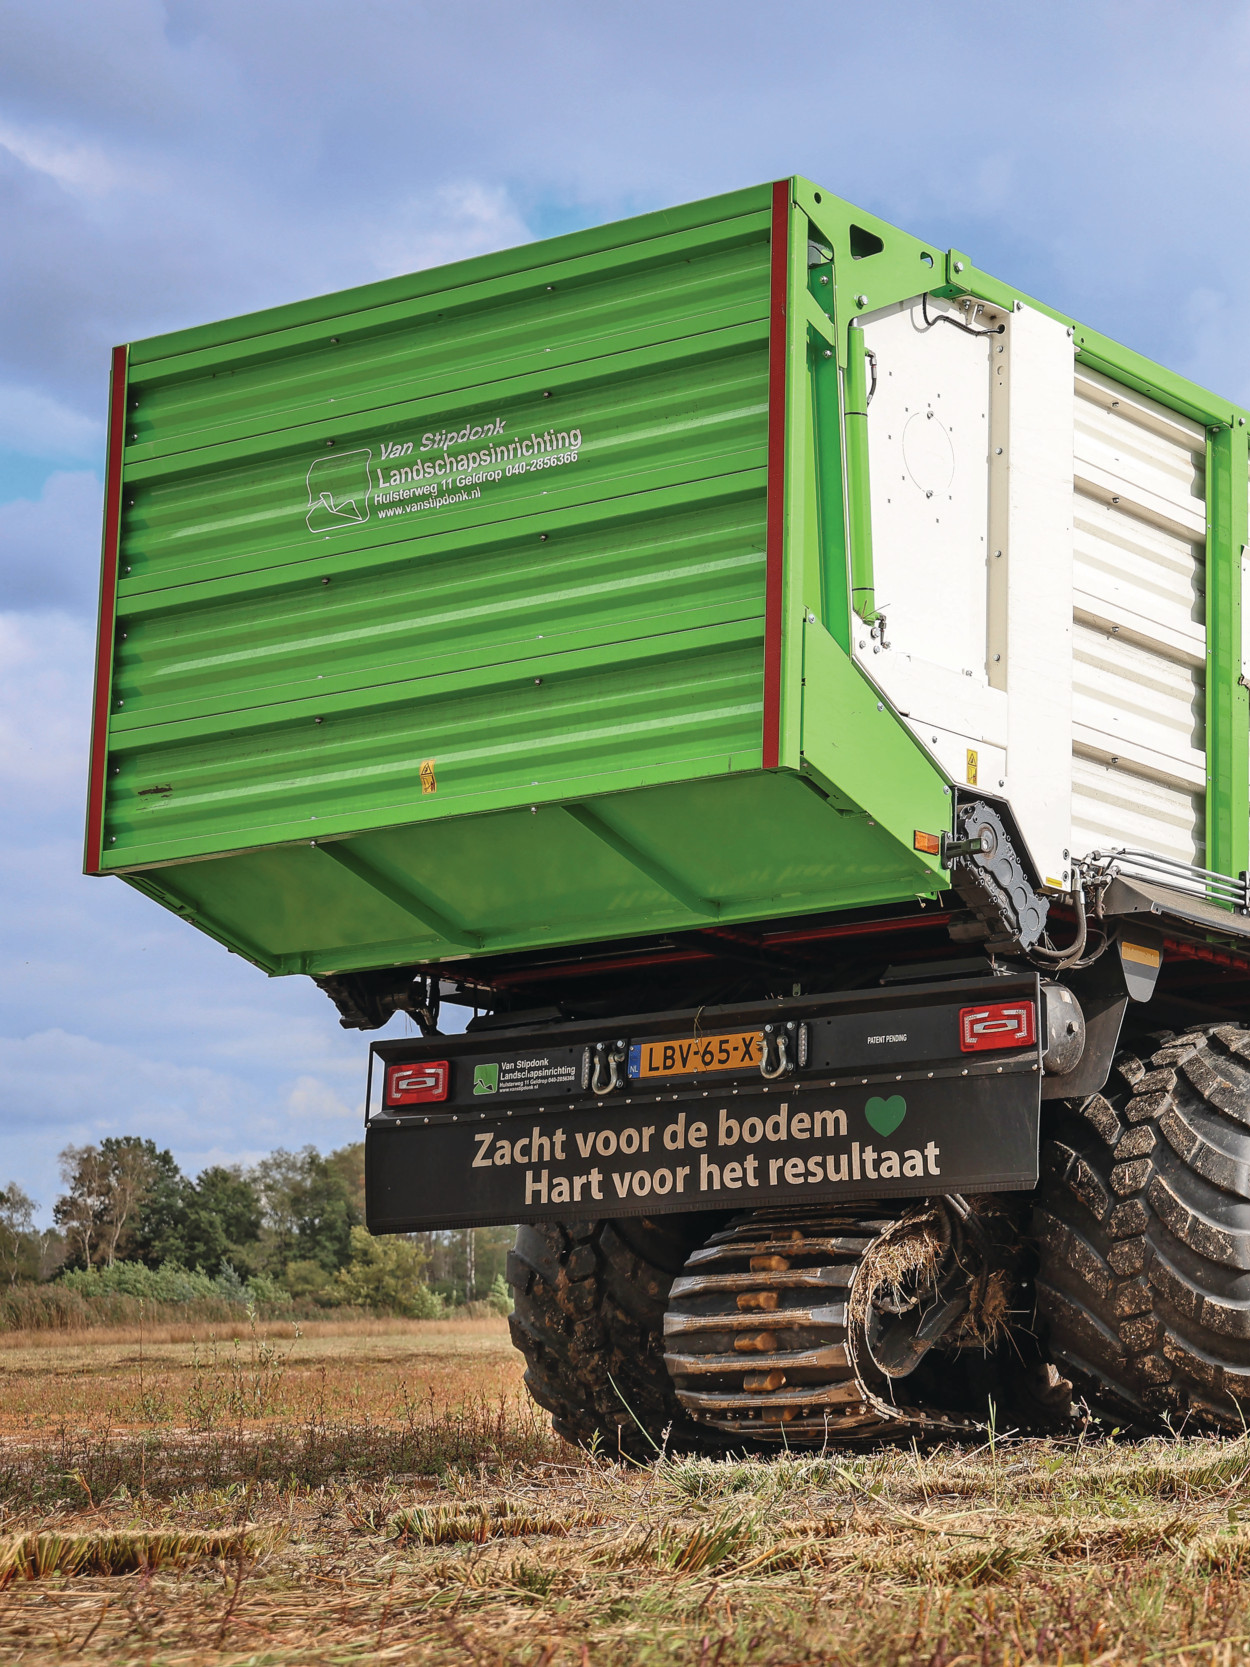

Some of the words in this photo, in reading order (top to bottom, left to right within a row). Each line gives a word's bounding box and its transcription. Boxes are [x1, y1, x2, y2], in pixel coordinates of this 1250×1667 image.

[377, 429, 583, 488] Landschapsinrichting
[379, 442, 413, 461] Van
[420, 417, 507, 452] Stipdonk
[375, 481, 438, 506] Hulsterweg
[441, 478, 453, 491] 11
[456, 467, 502, 488] Geldrop
[505, 451, 579, 477] 040-2856366
[377, 487, 481, 519] www.vanstipdonk.nl
[649, 1036, 754, 1072] LBV-65-X
[868, 1036, 885, 1044] PATENT
[886, 1033, 908, 1043] PENDING
[501, 1062, 515, 1070] Van
[516, 1057, 549, 1069] Stipdonk
[630, 1065, 639, 1073] NL
[472, 1126, 567, 1168] Zacht
[575, 1125, 655, 1159] voor
[663, 1112, 708, 1151] de
[718, 1103, 848, 1146] bodem
[524, 1167, 604, 1206] Hart
[611, 1164, 690, 1198] voor
[699, 1153, 760, 1192] het
[768, 1140, 941, 1186] resultaat
